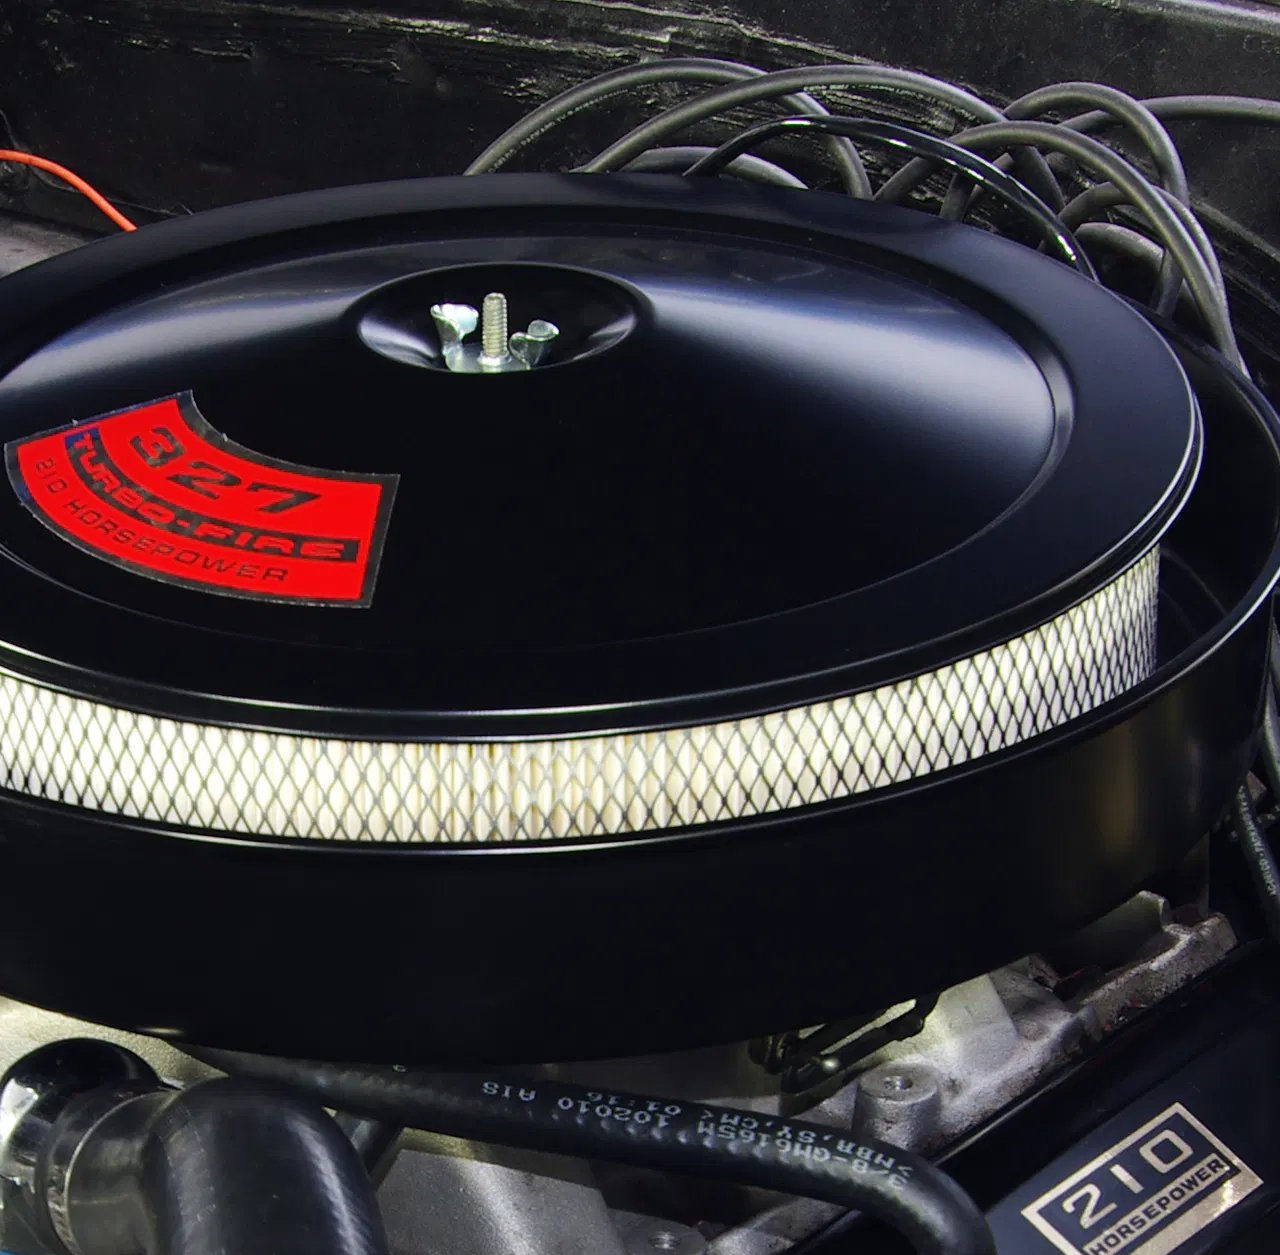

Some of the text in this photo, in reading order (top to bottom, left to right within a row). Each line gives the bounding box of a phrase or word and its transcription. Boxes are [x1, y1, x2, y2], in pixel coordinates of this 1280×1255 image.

[73, 431, 345, 559] TURBO-FIRE
[129, 426, 323, 514] 327
[35, 457, 289, 582] 210 HORSEPOWER
[481, 1080, 537, 1102] AIS
[557, 1096, 671, 1129] 102010
[1061, 1128, 1195, 1230] 210
